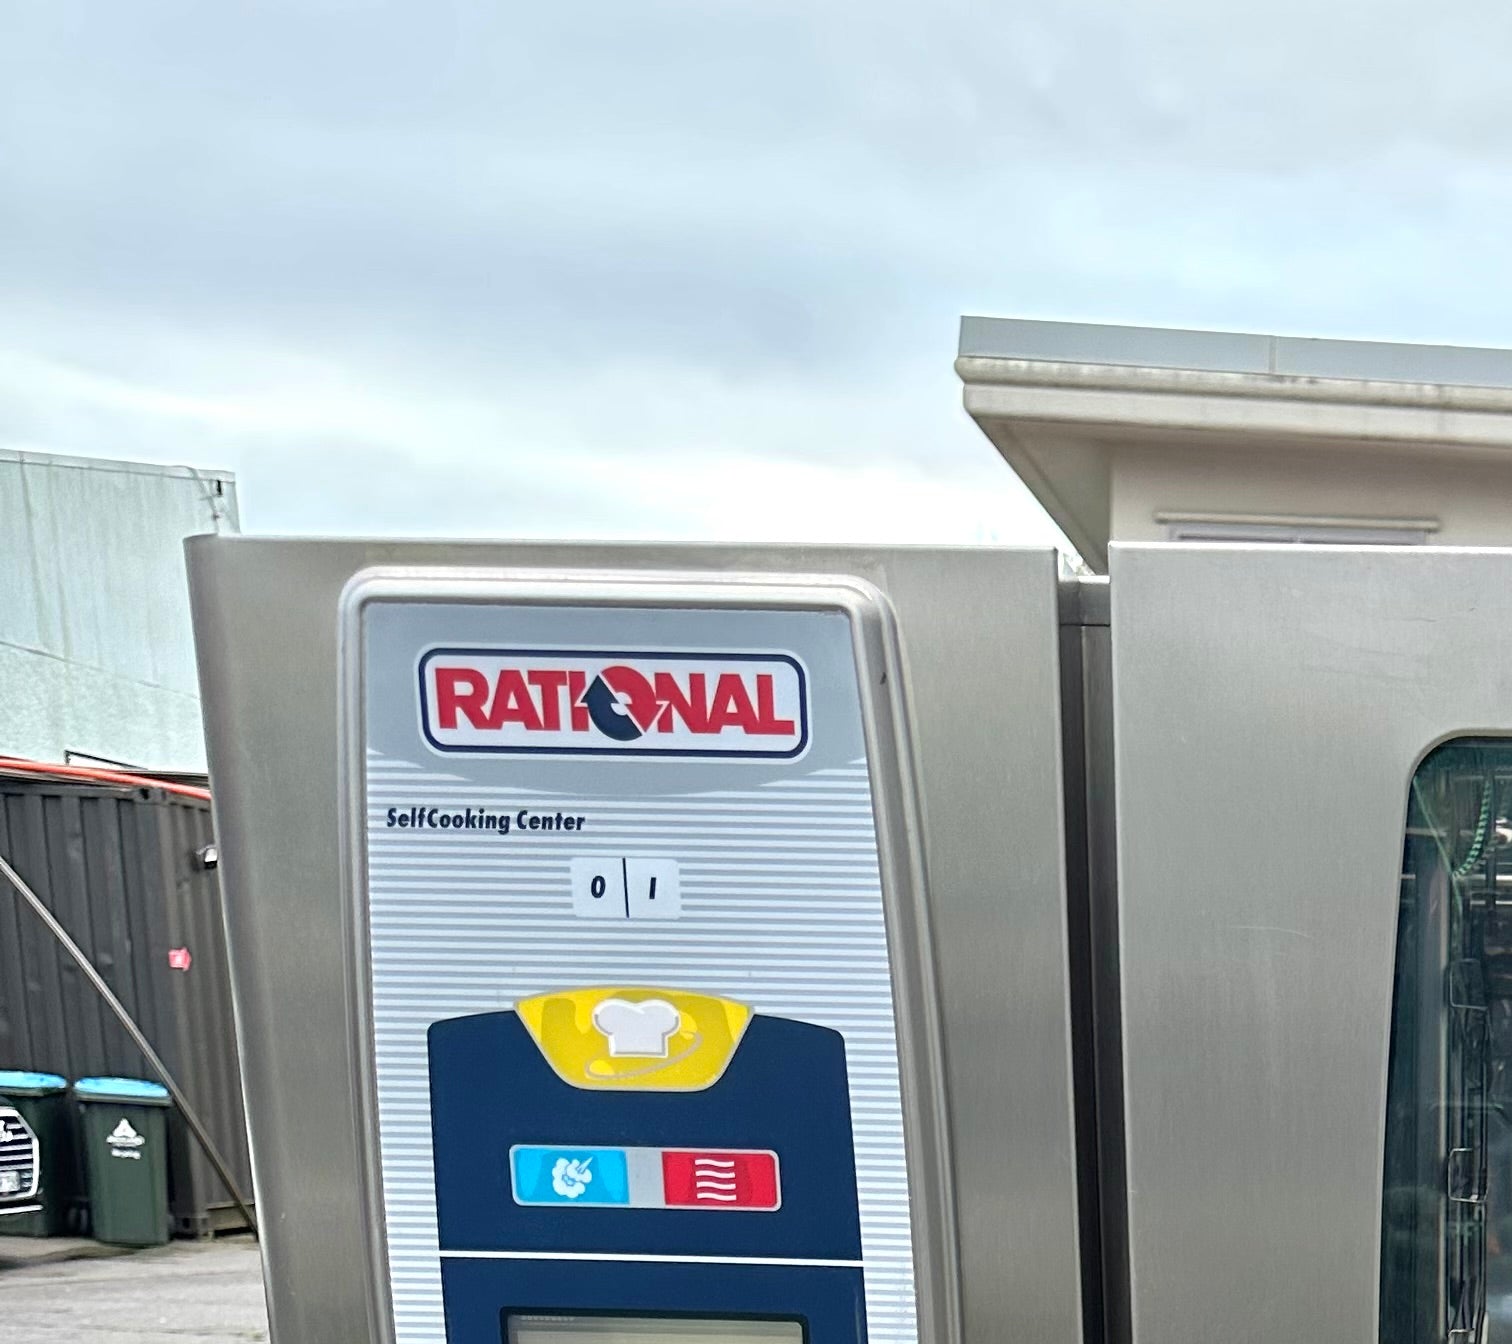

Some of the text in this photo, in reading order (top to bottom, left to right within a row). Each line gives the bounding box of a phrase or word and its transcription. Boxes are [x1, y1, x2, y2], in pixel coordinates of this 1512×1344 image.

[434, 665, 797, 742] RATIONAL
[386, 807, 586, 836] SelfCooking Center
